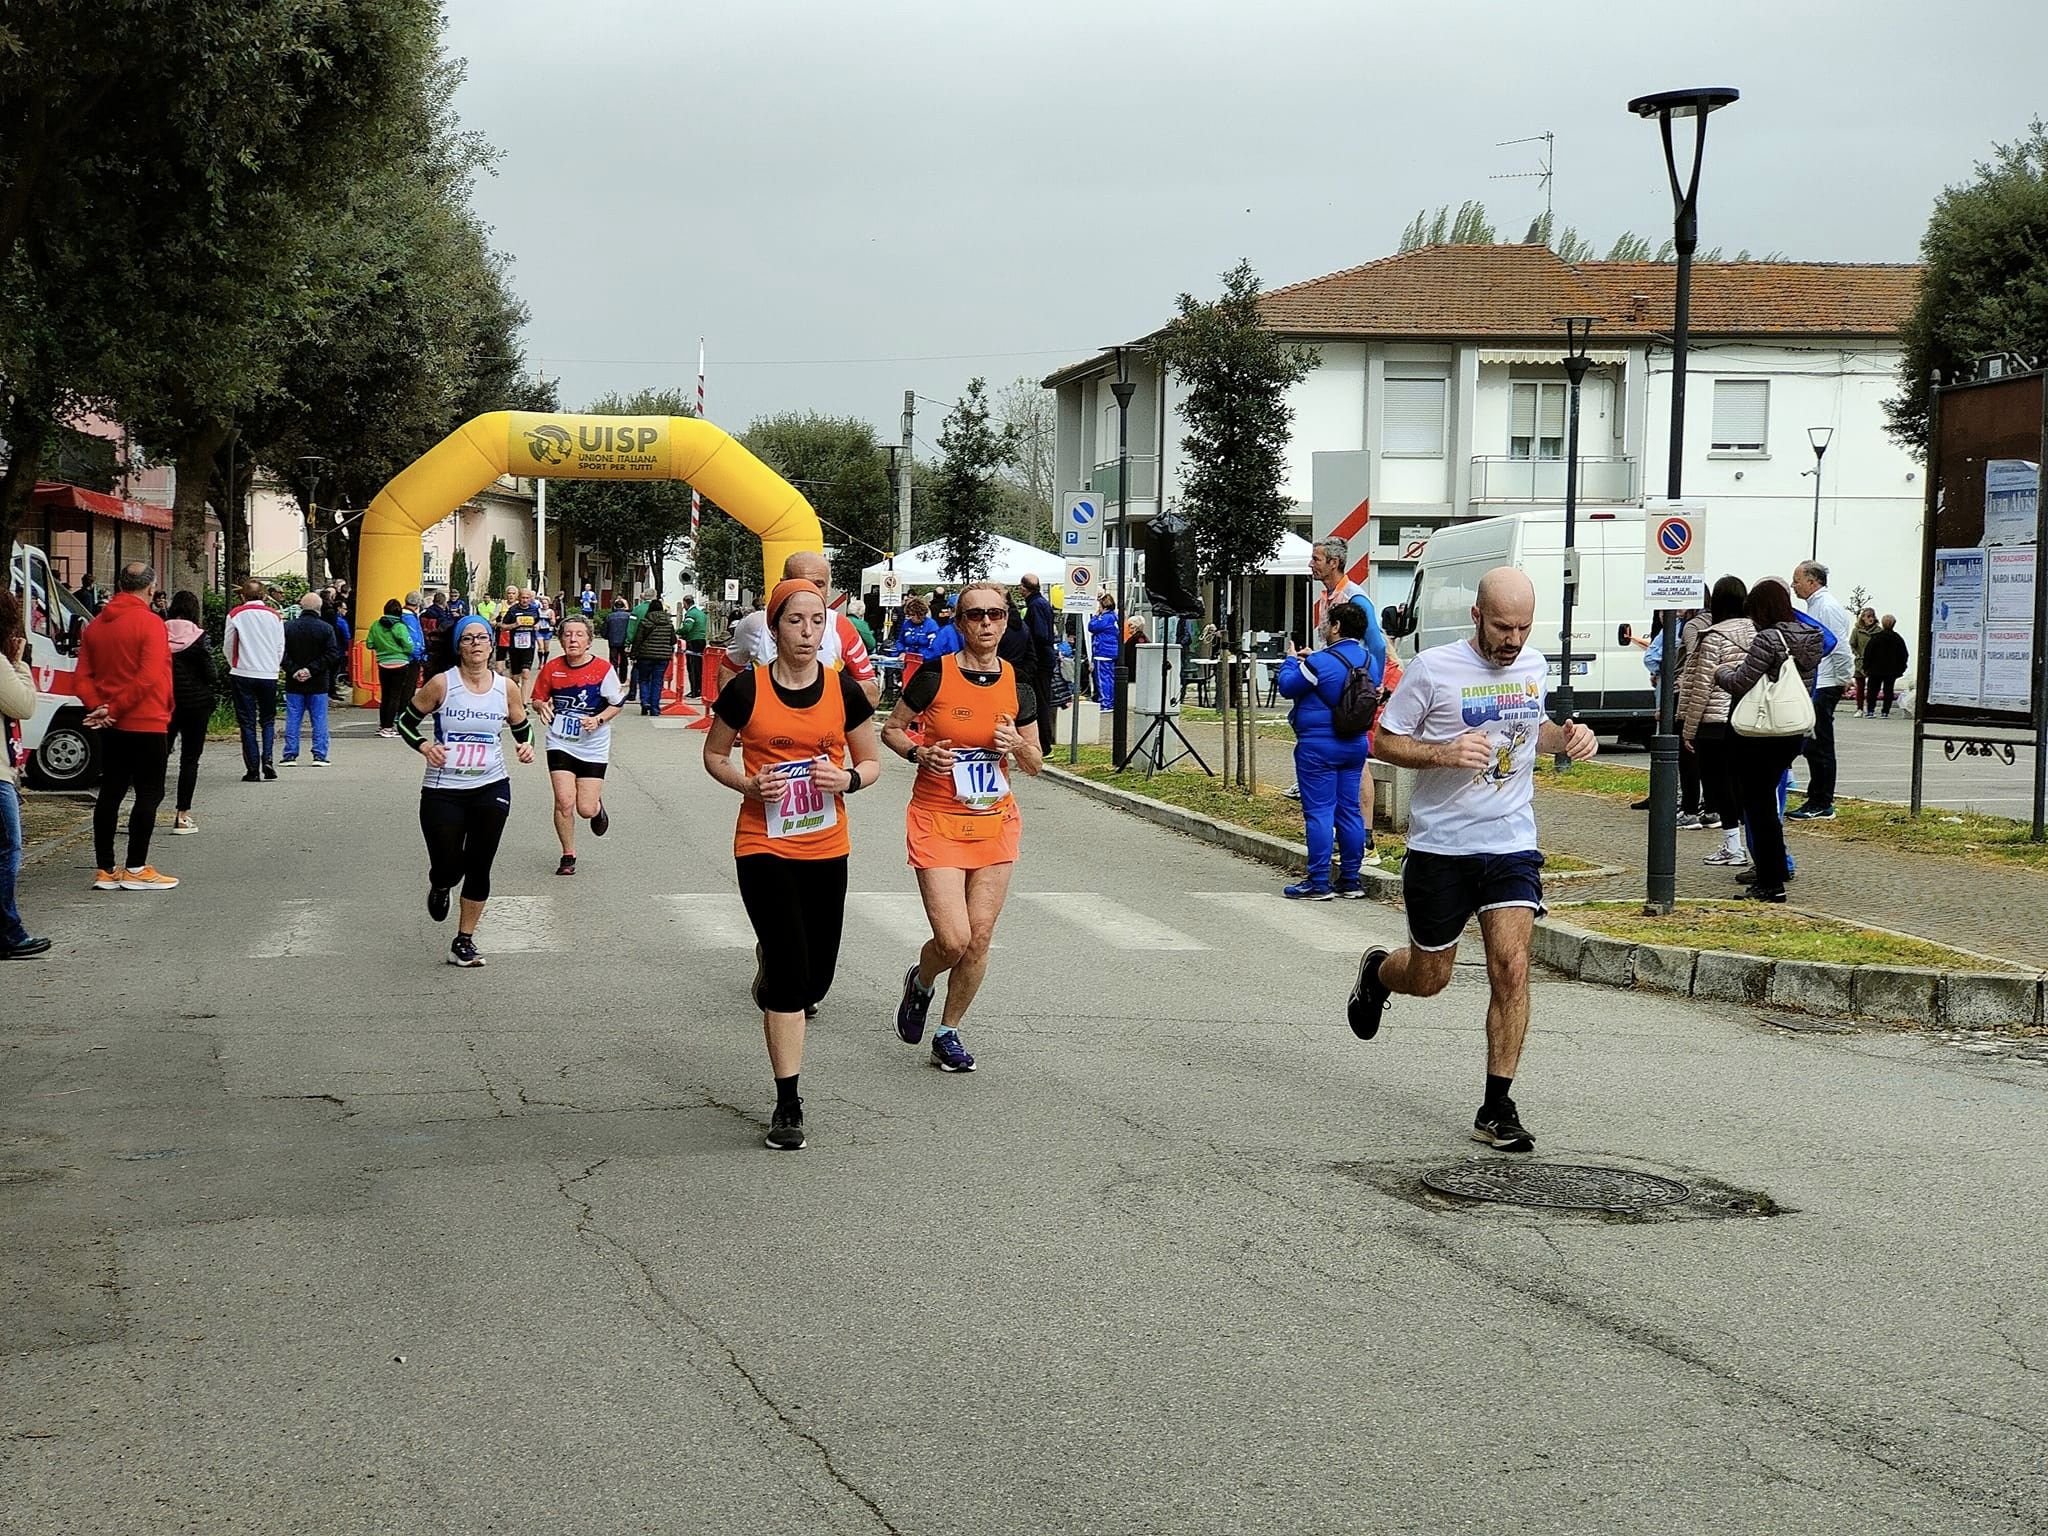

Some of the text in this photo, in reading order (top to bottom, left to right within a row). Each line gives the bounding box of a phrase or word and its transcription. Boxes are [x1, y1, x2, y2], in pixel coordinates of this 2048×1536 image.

[579, 426, 658, 453] UISP
[578, 454, 658, 463] UNIONE ITALIANA
[610, 463, 626, 471] PER
[1988, 490, 2036, 512] Ivan Alvisi
[1938, 648, 1978, 660] ALVISI IVAN
[1461, 683, 1523, 698] RAVENNA
[456, 744, 486, 767] 272
[967, 763, 998, 793] 112
[780, 780, 824, 817] 288
